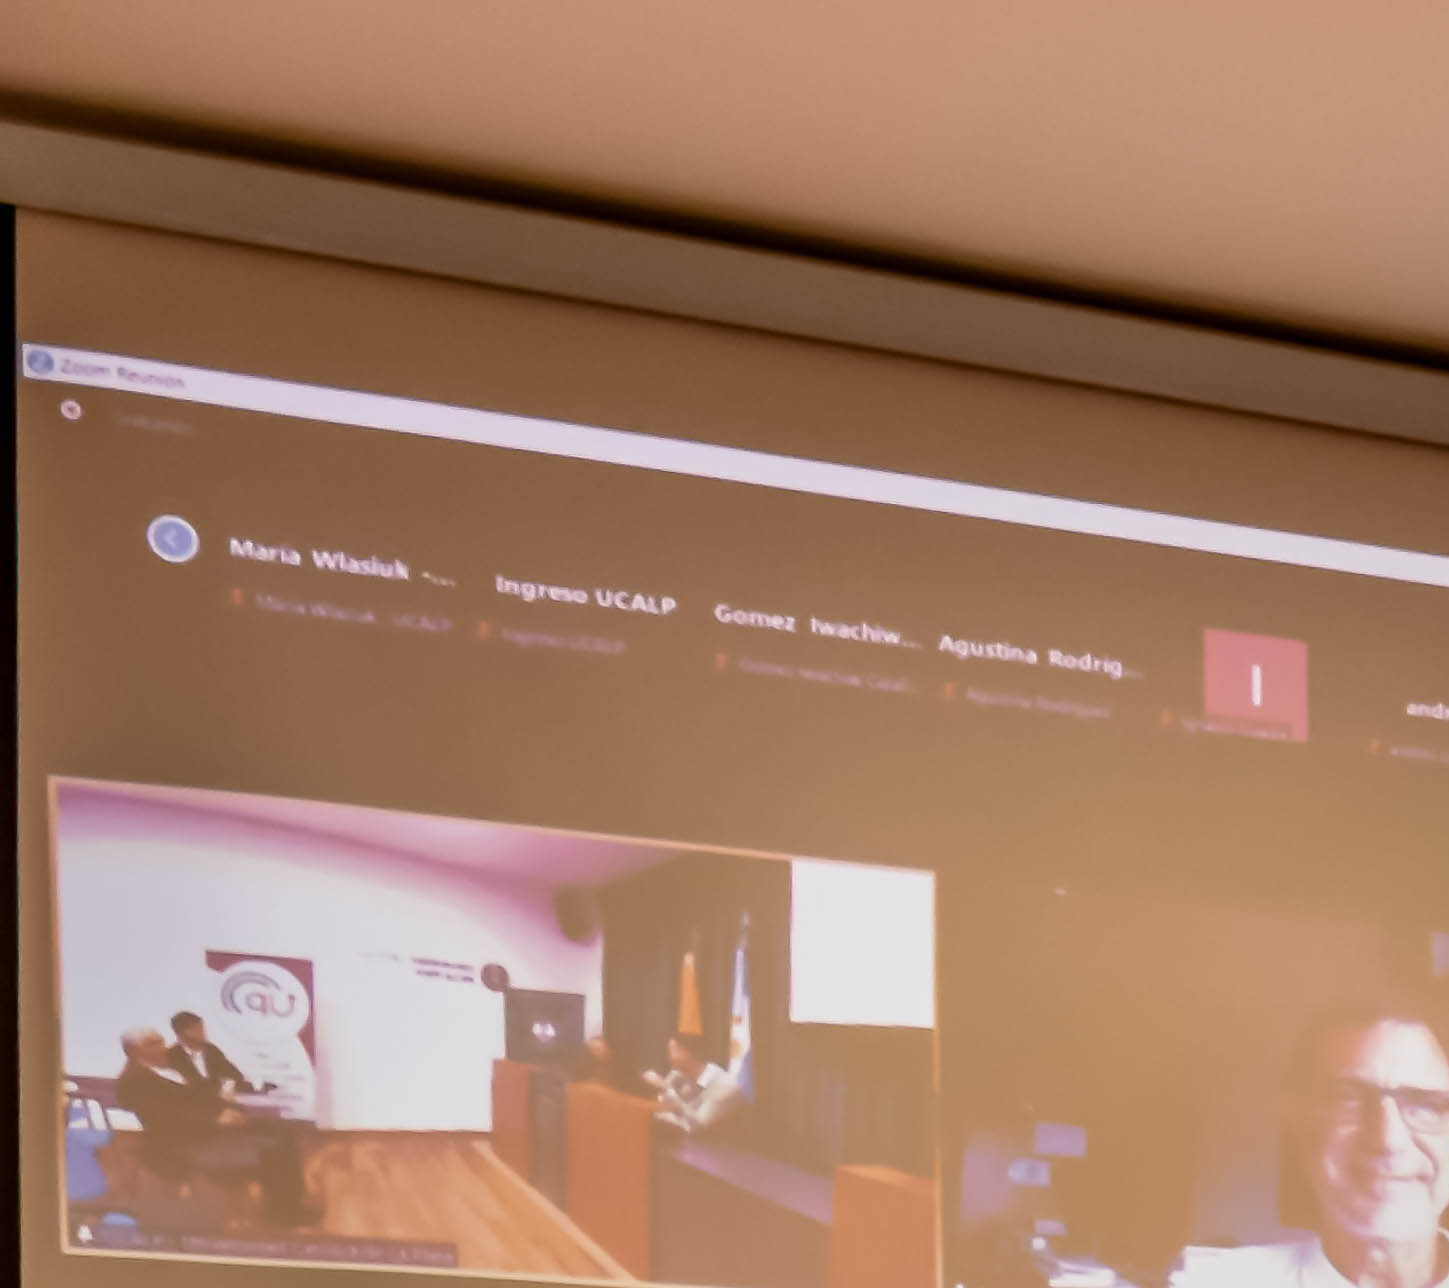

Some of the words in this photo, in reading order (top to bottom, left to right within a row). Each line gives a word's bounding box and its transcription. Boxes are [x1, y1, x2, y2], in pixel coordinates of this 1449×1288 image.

[495, 575, 588, 604] Ingreso
[595, 589, 677, 616] UCALP
[713, 603, 797, 633] Gomez
[939, 635, 1038, 665] Agustina
